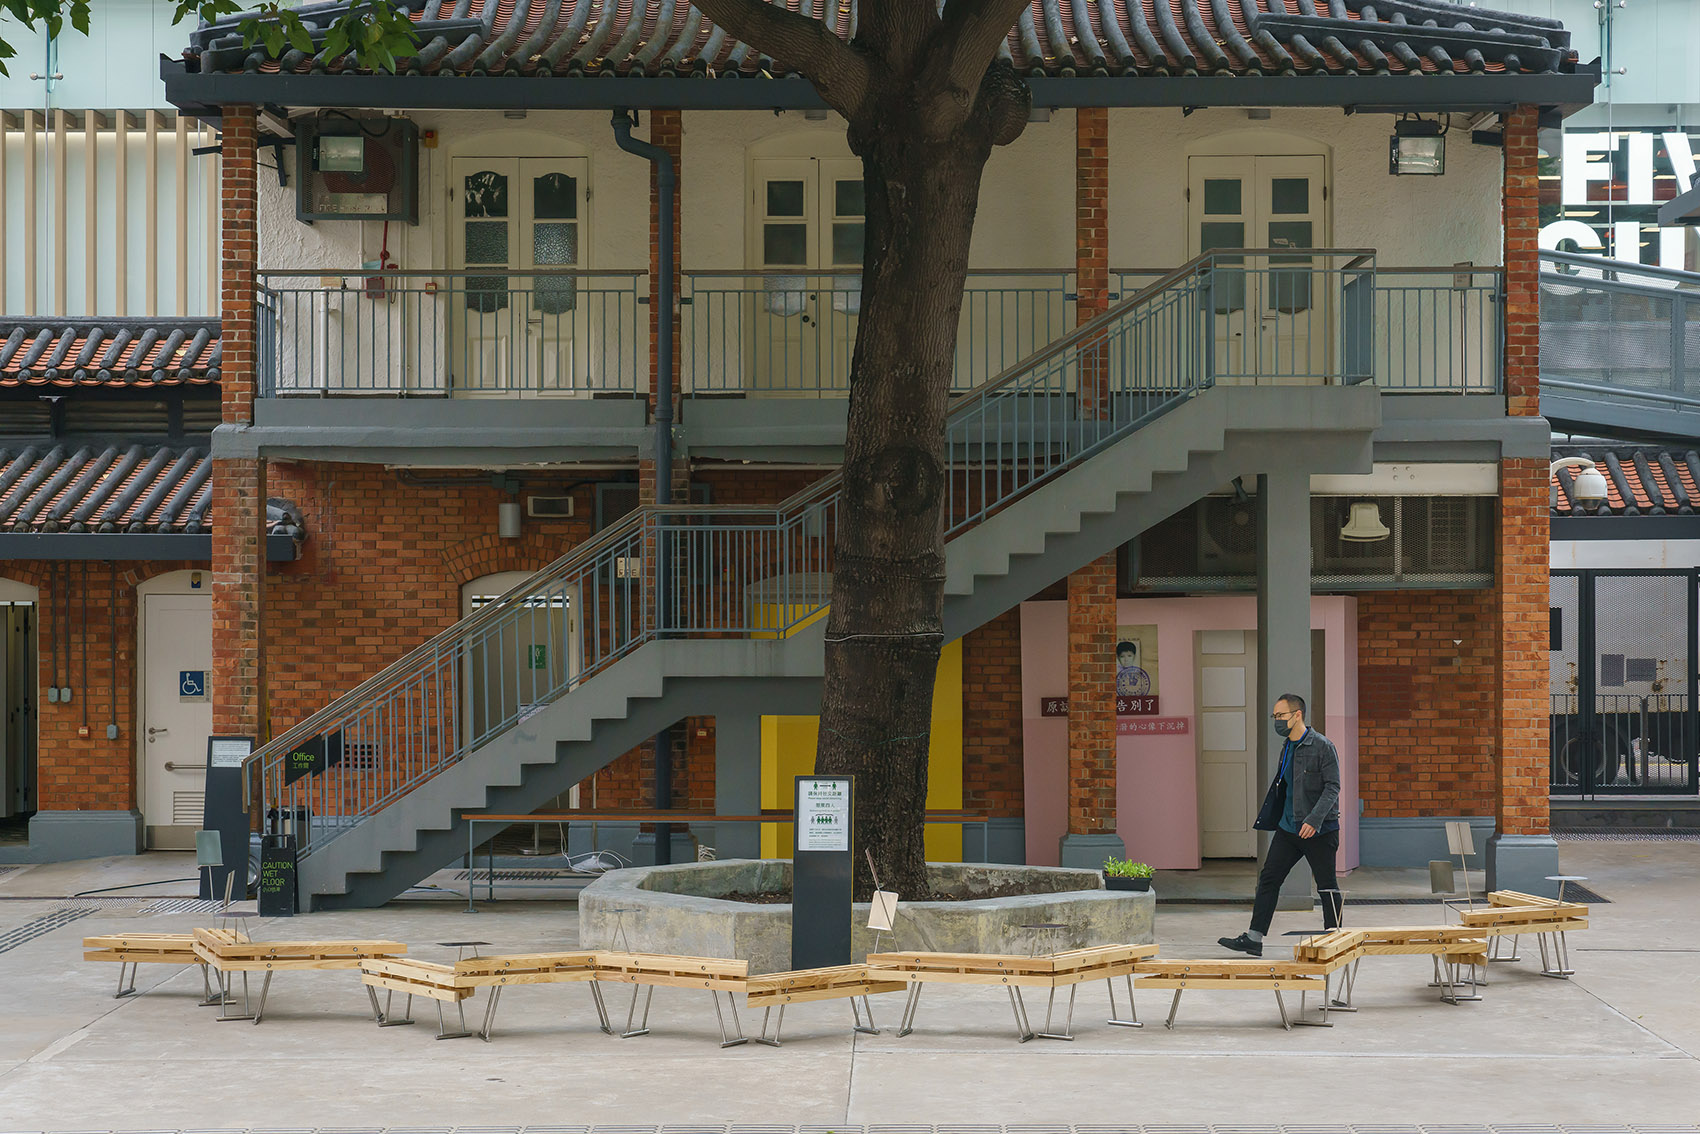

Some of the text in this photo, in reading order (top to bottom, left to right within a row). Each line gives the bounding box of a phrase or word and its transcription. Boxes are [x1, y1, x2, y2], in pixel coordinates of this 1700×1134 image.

[292, 751, 315, 762] Office
[262, 861, 293, 870] CAUTION
[262, 869, 279, 878] WET
[262, 878, 286, 886] FLOOR
